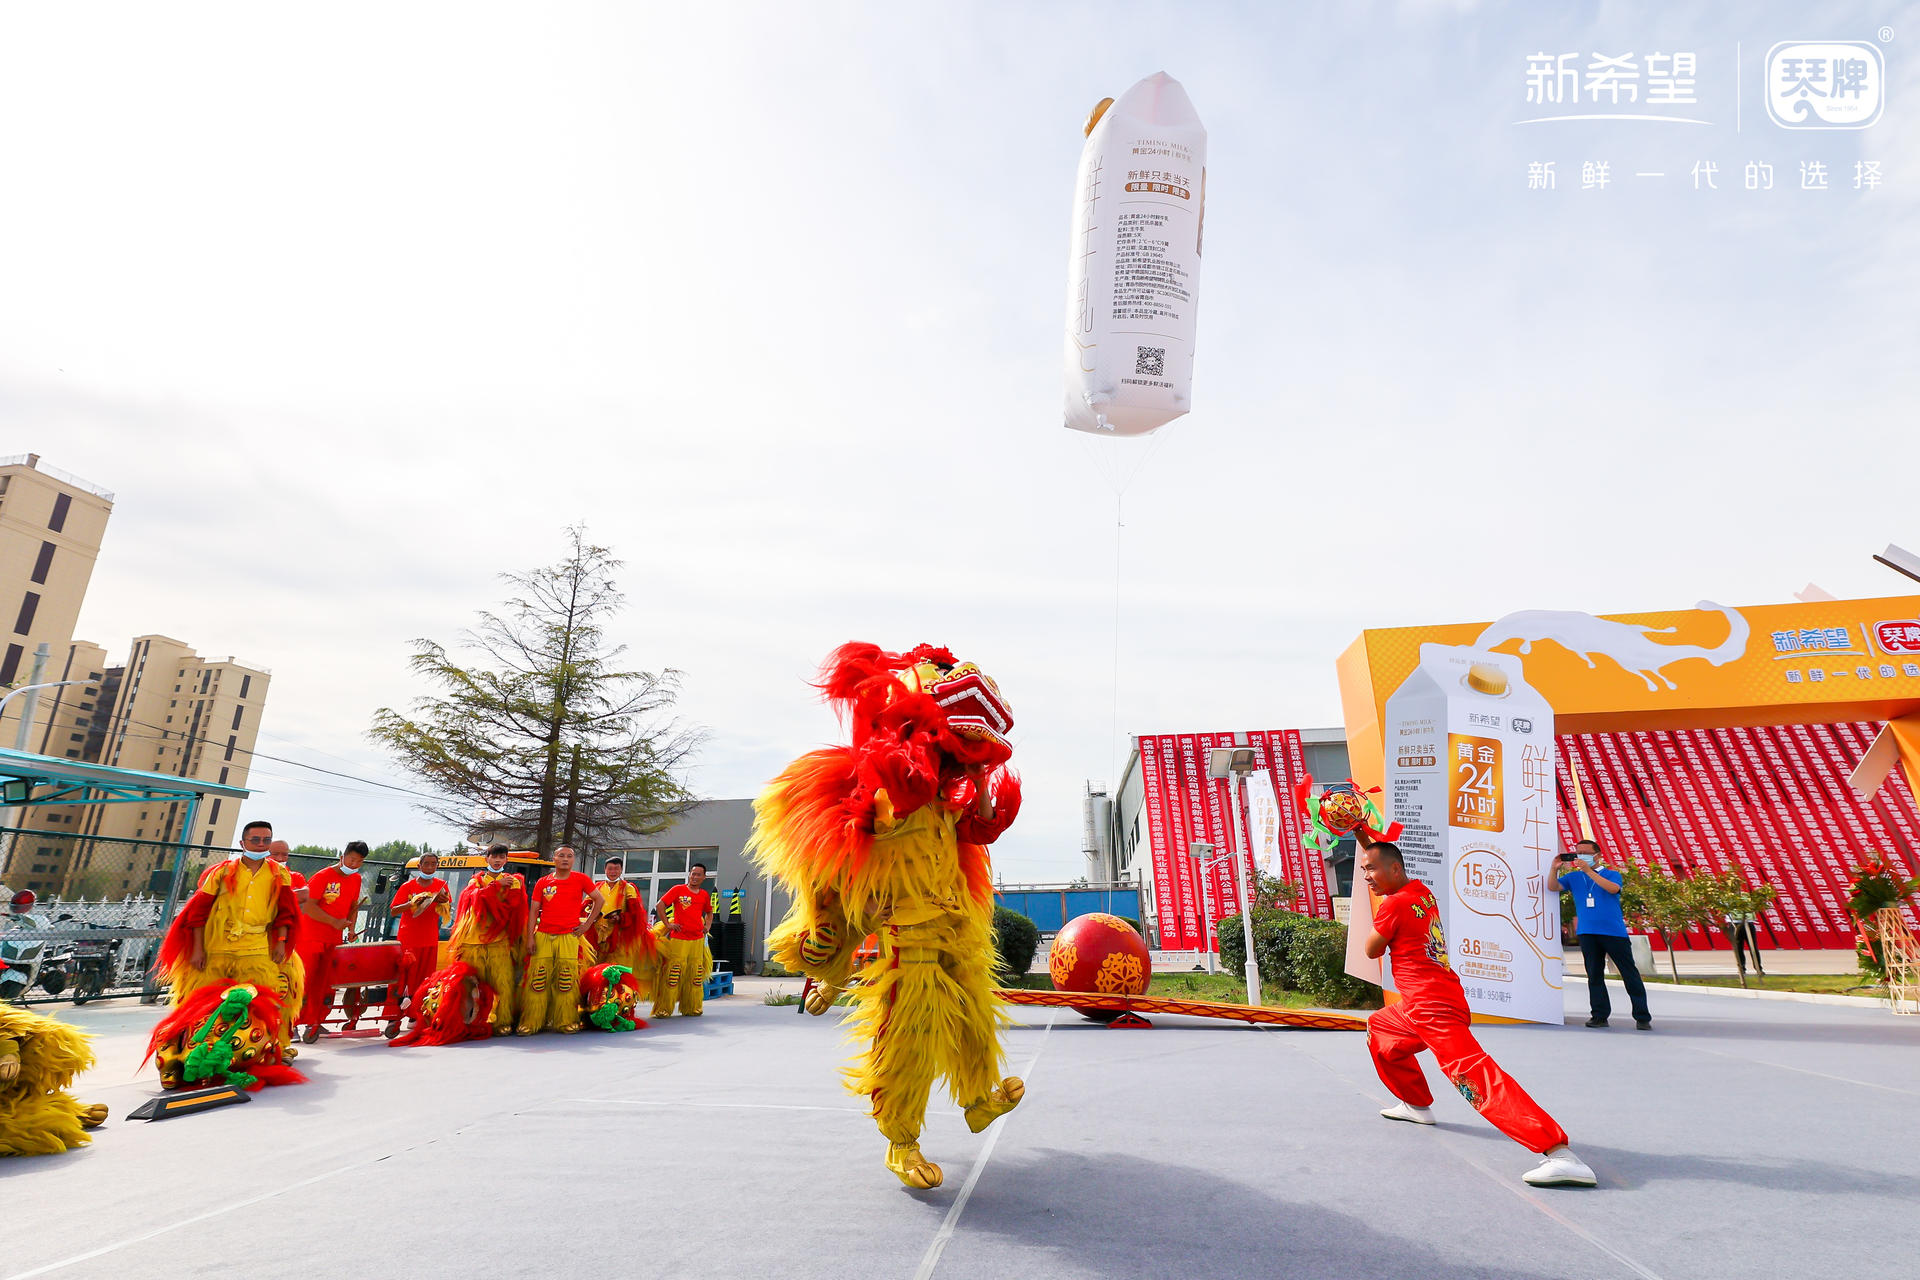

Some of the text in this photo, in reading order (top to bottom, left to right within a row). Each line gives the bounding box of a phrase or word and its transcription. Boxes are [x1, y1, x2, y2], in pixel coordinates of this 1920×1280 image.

[1132, 148, 1170, 156] 黄金24小时
[1128, 170, 1190, 188] 新鲜只卖当天
[1771, 628, 1853, 652] 新希望
[1470, 713, 1500, 726] 新希望
[1398, 744, 1436, 754] 新鲜只卖当天
[1457, 742, 1495, 764] 黄金
[1458, 763, 1496, 796] 24
[1456, 794, 1496, 816] 小时
[1521, 744, 1554, 940] 鲜牛乳
[1463, 862, 1482, 887] 15
[1464, 888, 1506, 901] 免疫球蛋白
[1463, 938, 1480, 955] 3.6
